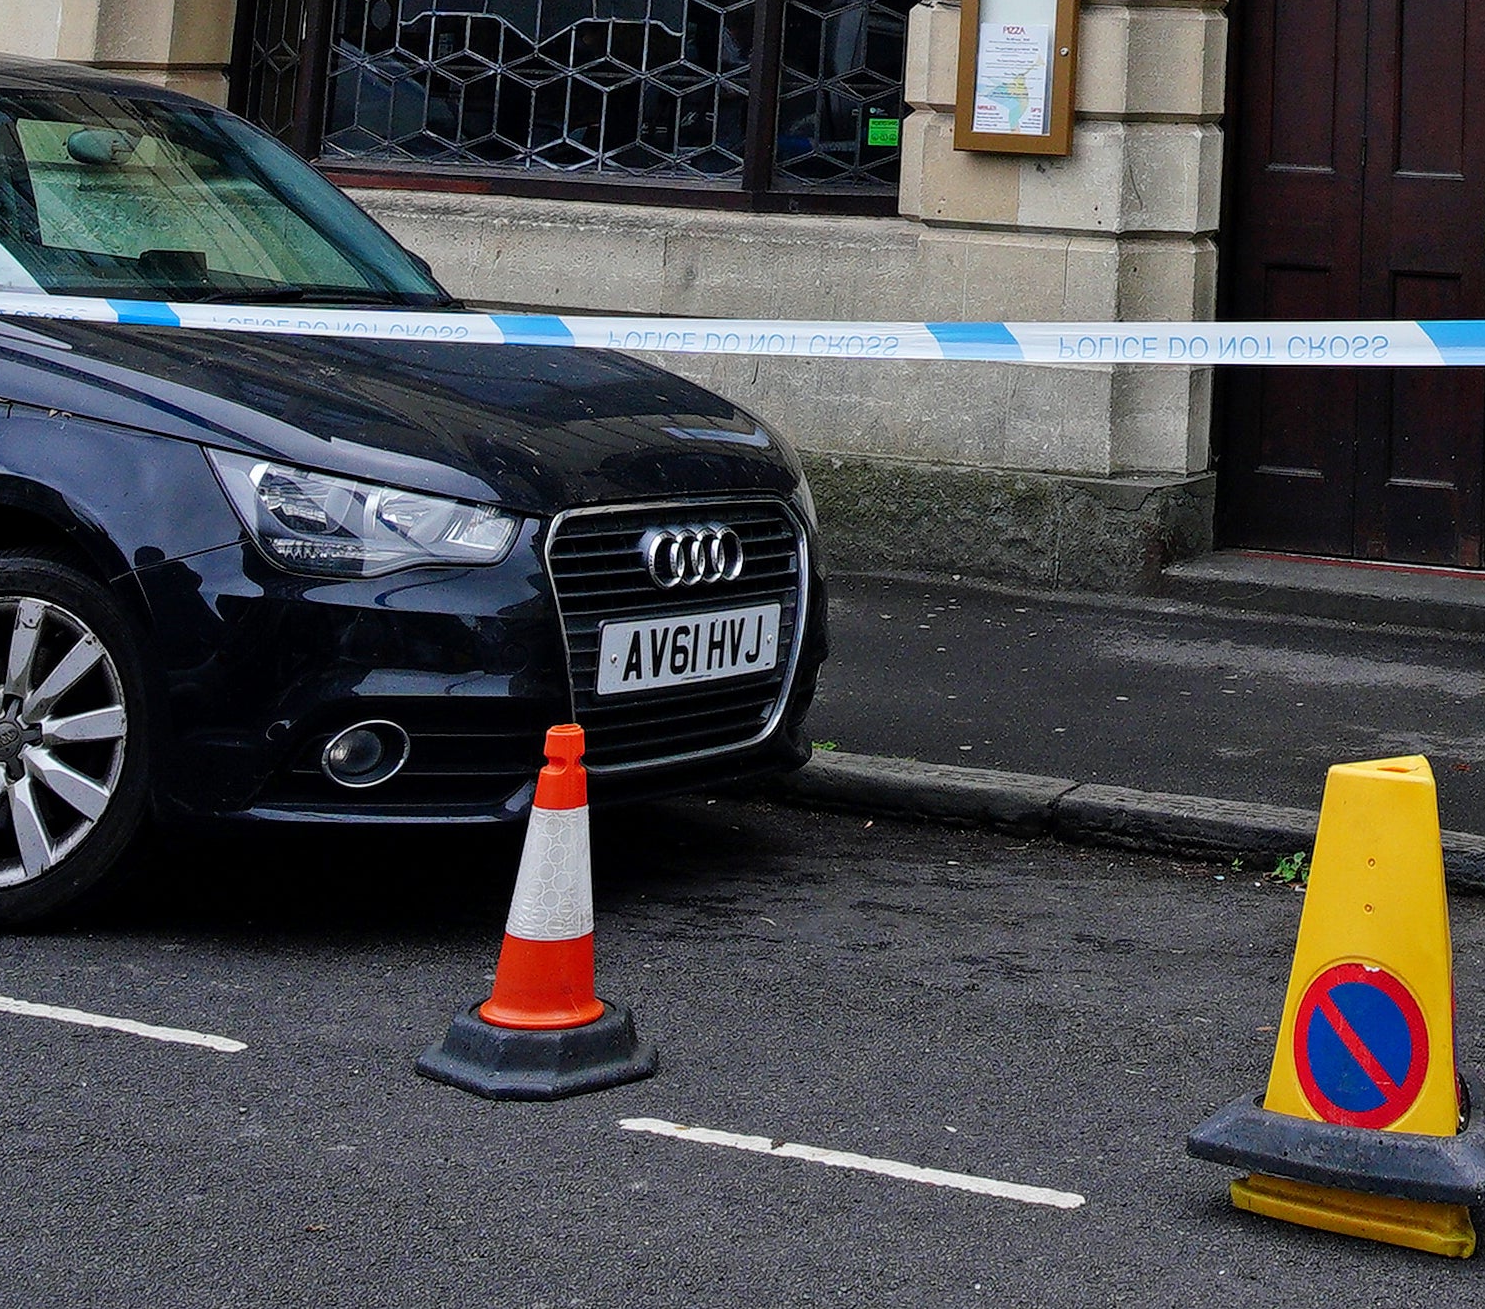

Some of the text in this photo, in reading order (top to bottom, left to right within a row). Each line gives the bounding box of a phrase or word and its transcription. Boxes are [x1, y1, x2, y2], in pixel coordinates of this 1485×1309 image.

[1002, 26, 1026, 36] PIZZA
[622, 614, 765, 682] AV61 HVJ
